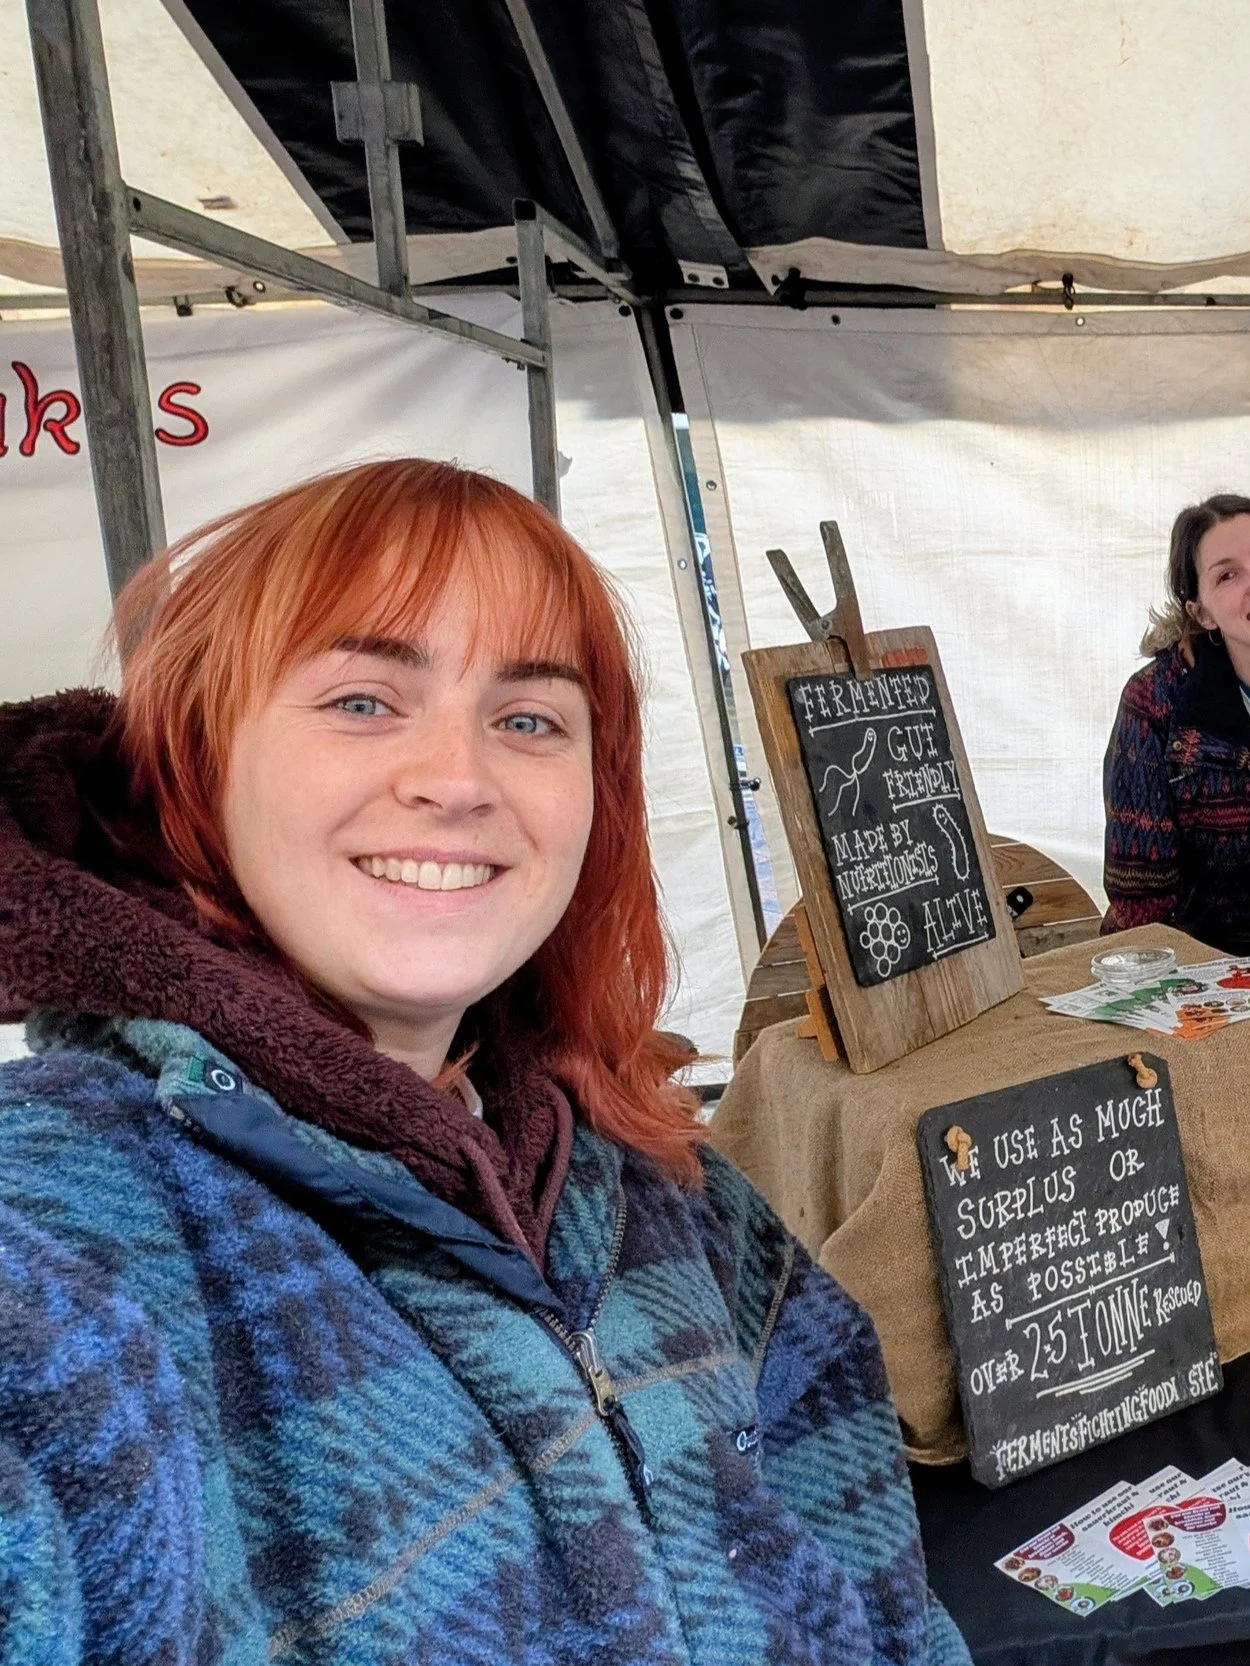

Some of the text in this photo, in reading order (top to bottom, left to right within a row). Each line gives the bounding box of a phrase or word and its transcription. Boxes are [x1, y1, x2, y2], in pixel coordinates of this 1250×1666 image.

[799, 674, 930, 721] FERMENTED
[887, 723, 939, 762] GUT
[882, 760, 960, 800] FRIENDLY
[831, 818, 914, 867] MADE BY
[836, 844, 940, 900] NUTRITIONISTS
[922, 889, 988, 952] ALIVE
[939, 1087, 1166, 1187] WE USE AS MUCH
[956, 1147, 1146, 1241] SURPLUS OR
[954, 1183, 1181, 1290] IMPERFECT PRODUCE
[969, 1282, 1005, 1324] AS
[970, 1349, 1025, 1396] OVER
[1067, 1277, 1155, 1373] TONNE
[1152, 1279, 1203, 1328] RESCUED
[994, 1421, 1078, 1482] FERMENTS
[1137, 1381, 1176, 1422] FOOD
[1070, 1485, 1133, 1530] How to use our
[1082, 1494, 1131, 1532] sauerkraut
